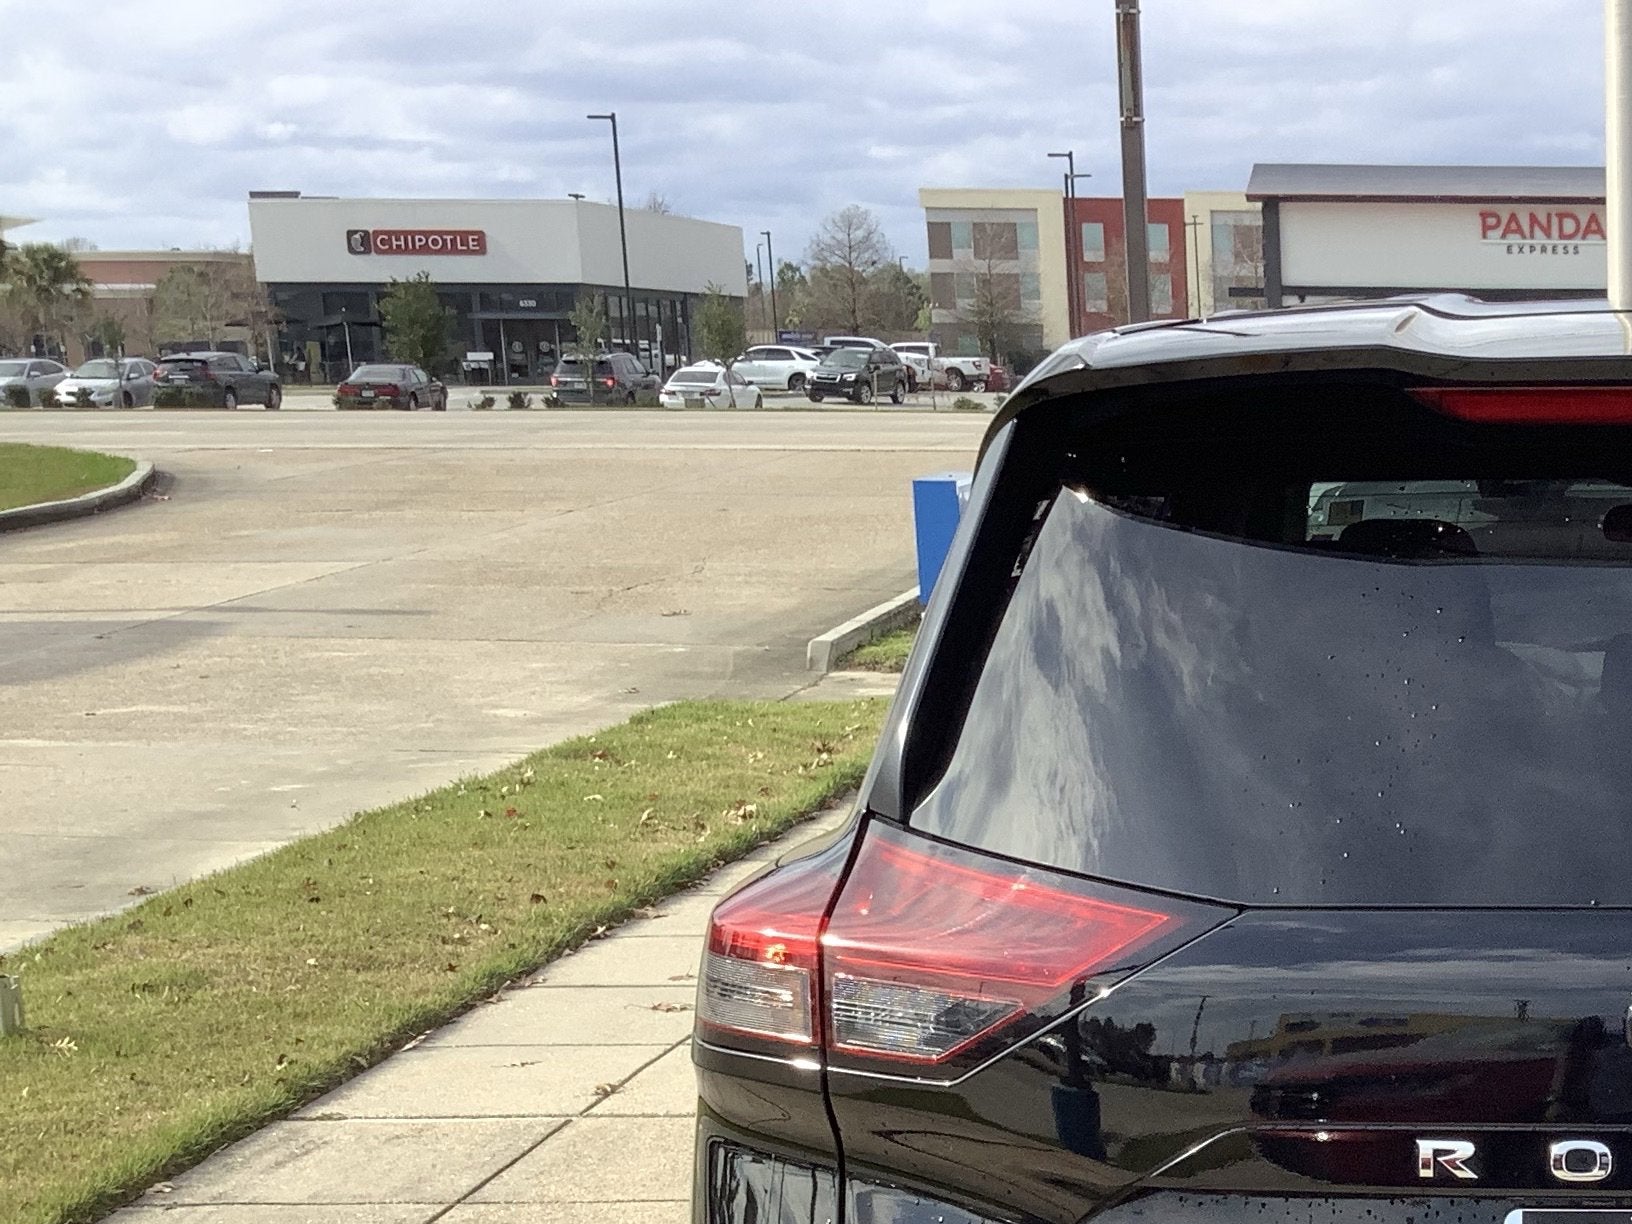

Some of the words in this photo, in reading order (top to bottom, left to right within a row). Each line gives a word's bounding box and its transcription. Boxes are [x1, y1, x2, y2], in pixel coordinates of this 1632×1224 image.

[1479, 211, 1607, 240] PANDA
[376, 235, 480, 251] CHIPOTLE
[1506, 244, 1580, 255] EXPRESS
